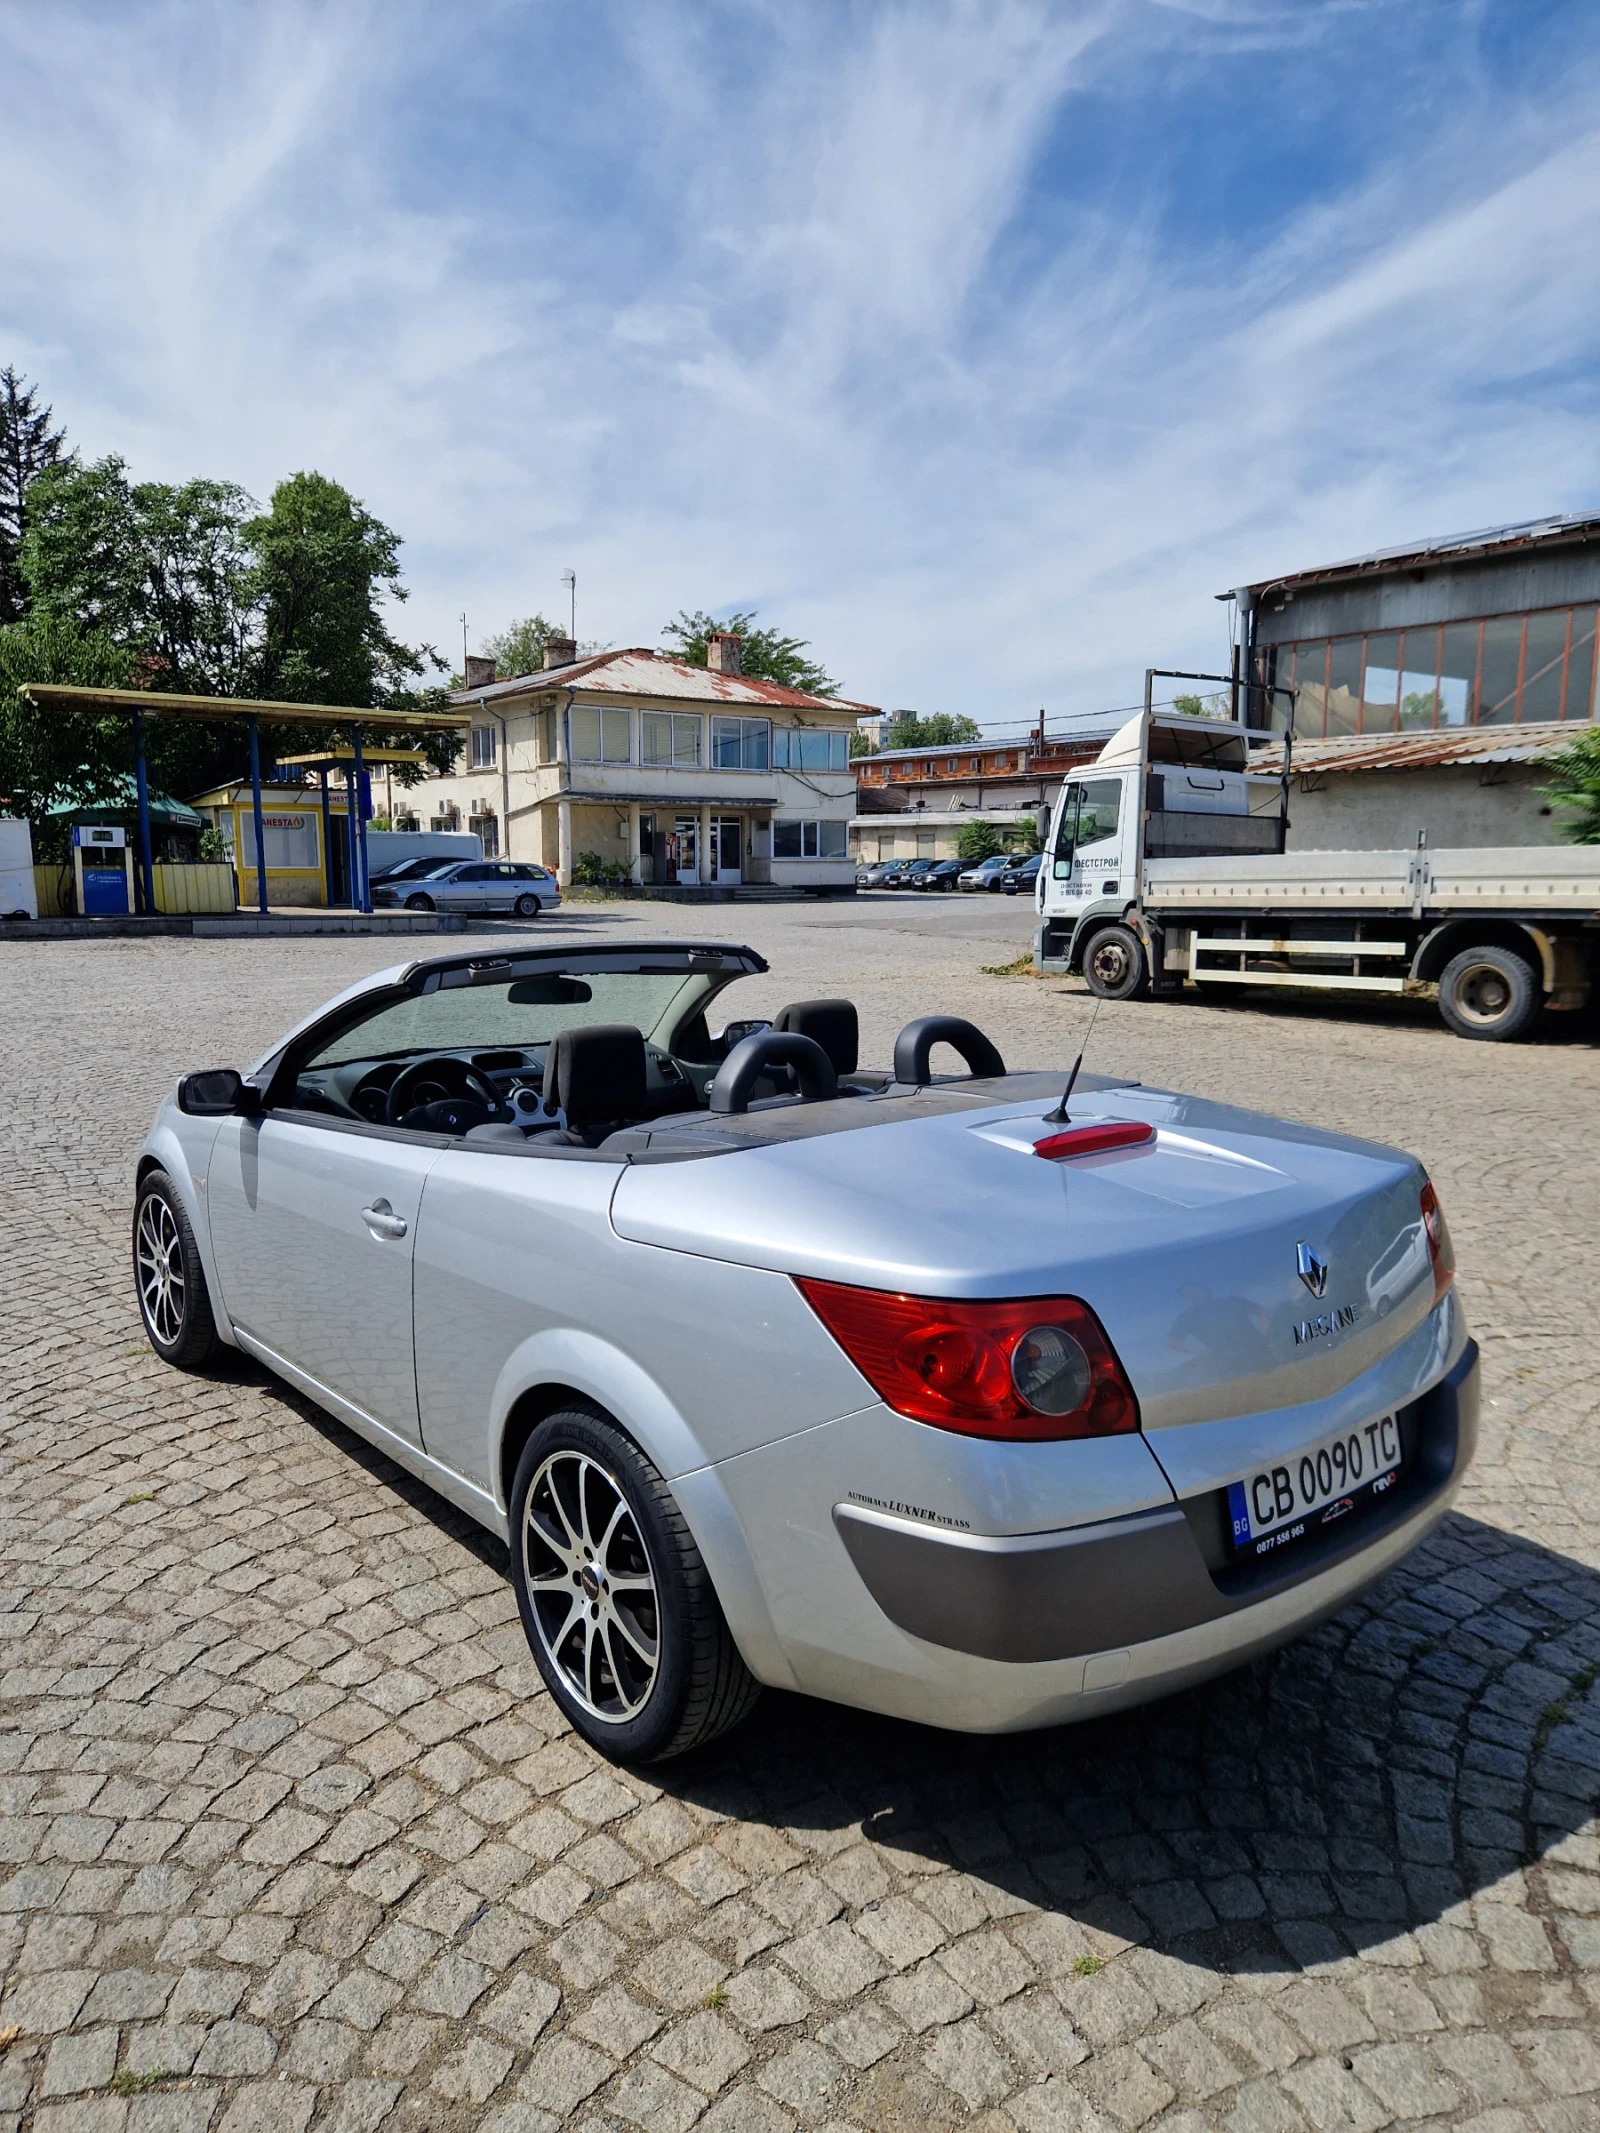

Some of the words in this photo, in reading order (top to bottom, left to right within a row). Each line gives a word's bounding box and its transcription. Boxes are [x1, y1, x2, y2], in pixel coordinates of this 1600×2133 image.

[262, 818, 293, 827] ANESTA
[1074, 857, 1119, 868] ФЕСТСТРОЙ
[1293, 1304, 1359, 1346] MEGANE
[1252, 1467, 1295, 1526] CB
[1300, 1433, 1363, 1505] 0090
[1364, 1416, 1396, 1470] TC
[847, 1491, 888, 1508] AUTOHAUS
[889, 1500, 937, 1521] LUXNER
[937, 1515, 971, 1529] STRASS
[1233, 1518, 1249, 1535] BG
[1256, 1537, 1275, 1554] 0877
